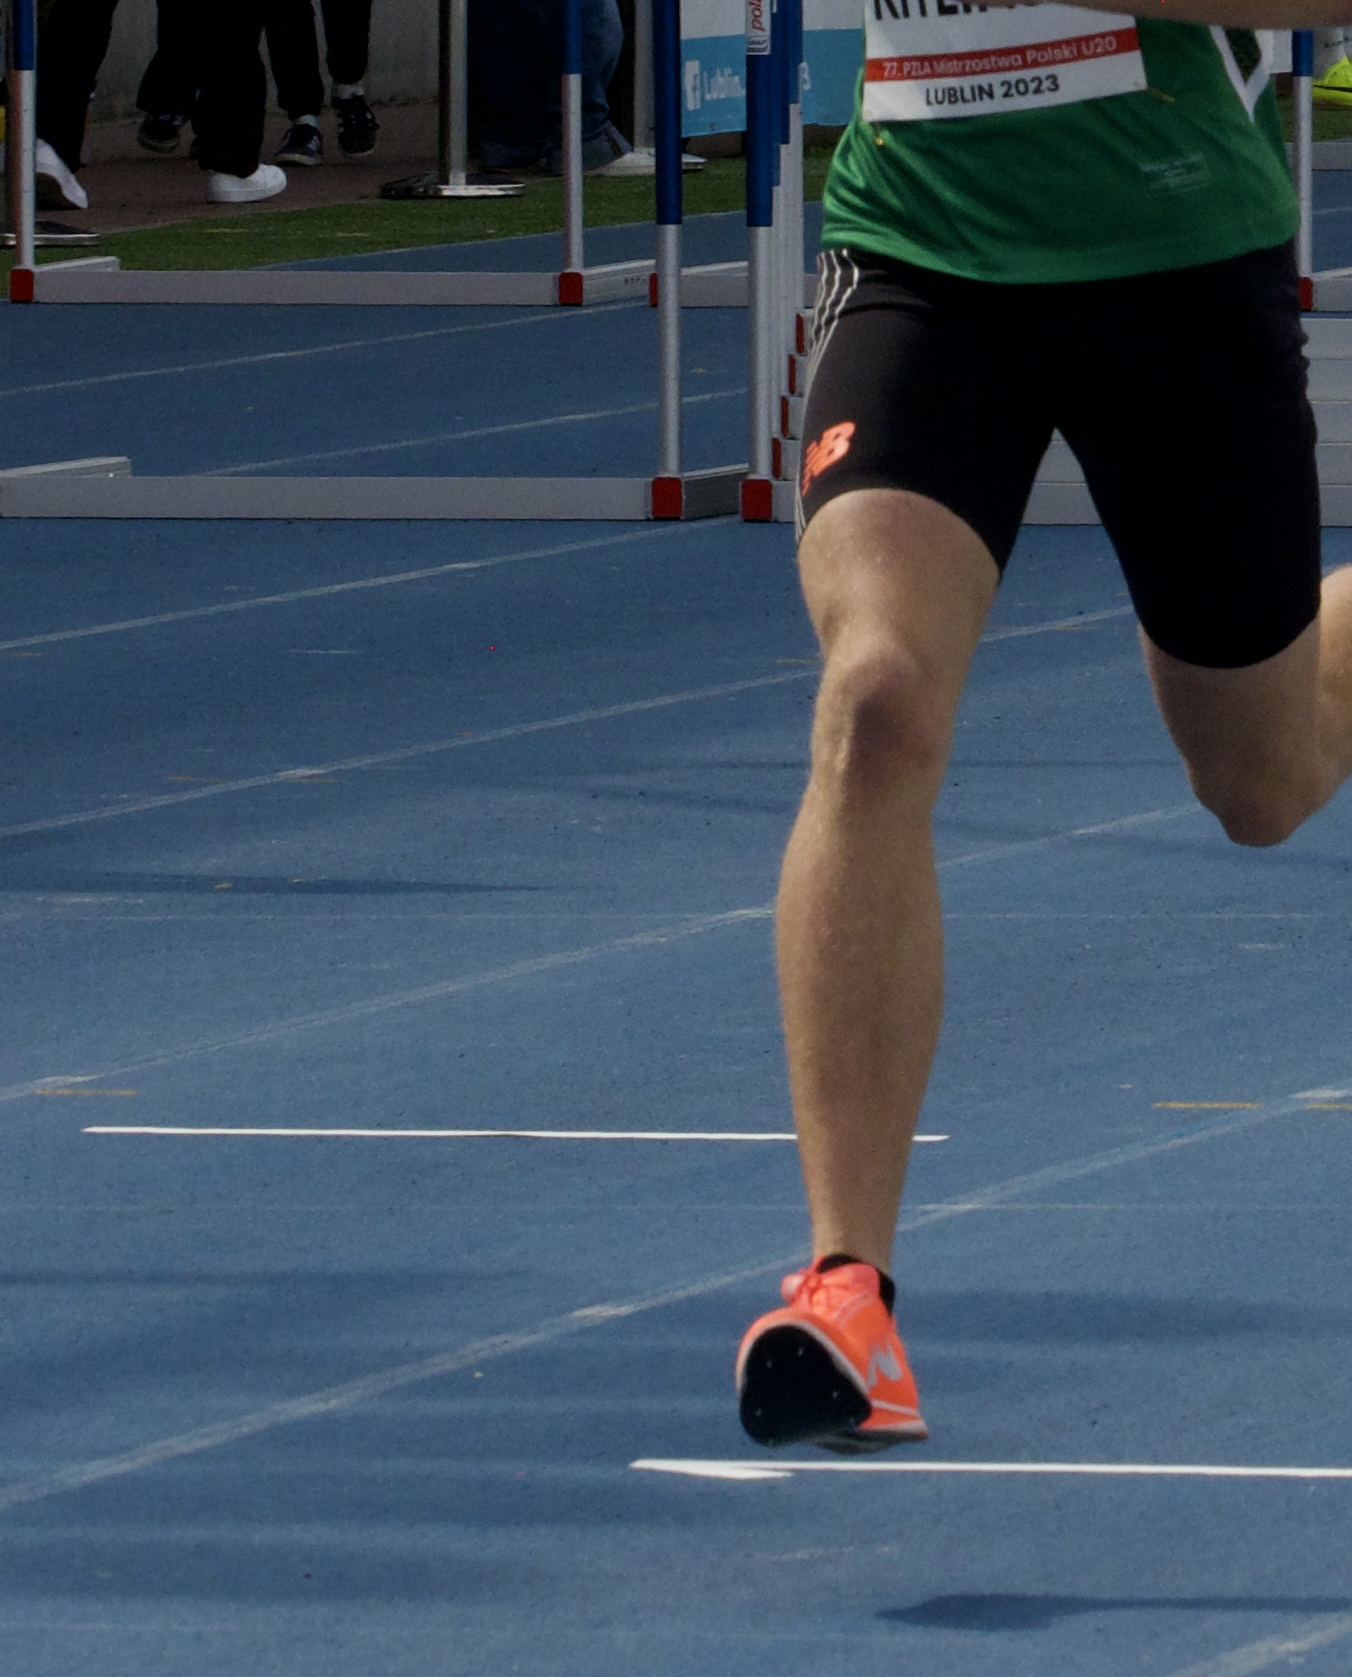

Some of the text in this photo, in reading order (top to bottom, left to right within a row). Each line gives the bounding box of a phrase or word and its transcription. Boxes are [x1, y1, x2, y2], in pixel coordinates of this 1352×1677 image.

[903, 57, 932, 76] PZLA
[933, 50, 1024, 74] Mistrzostwa
[1026, 42, 1078, 64] Polski
[1080, 35, 1118, 56] U20
[925, 74, 1060, 106] LUBLIN 2023
